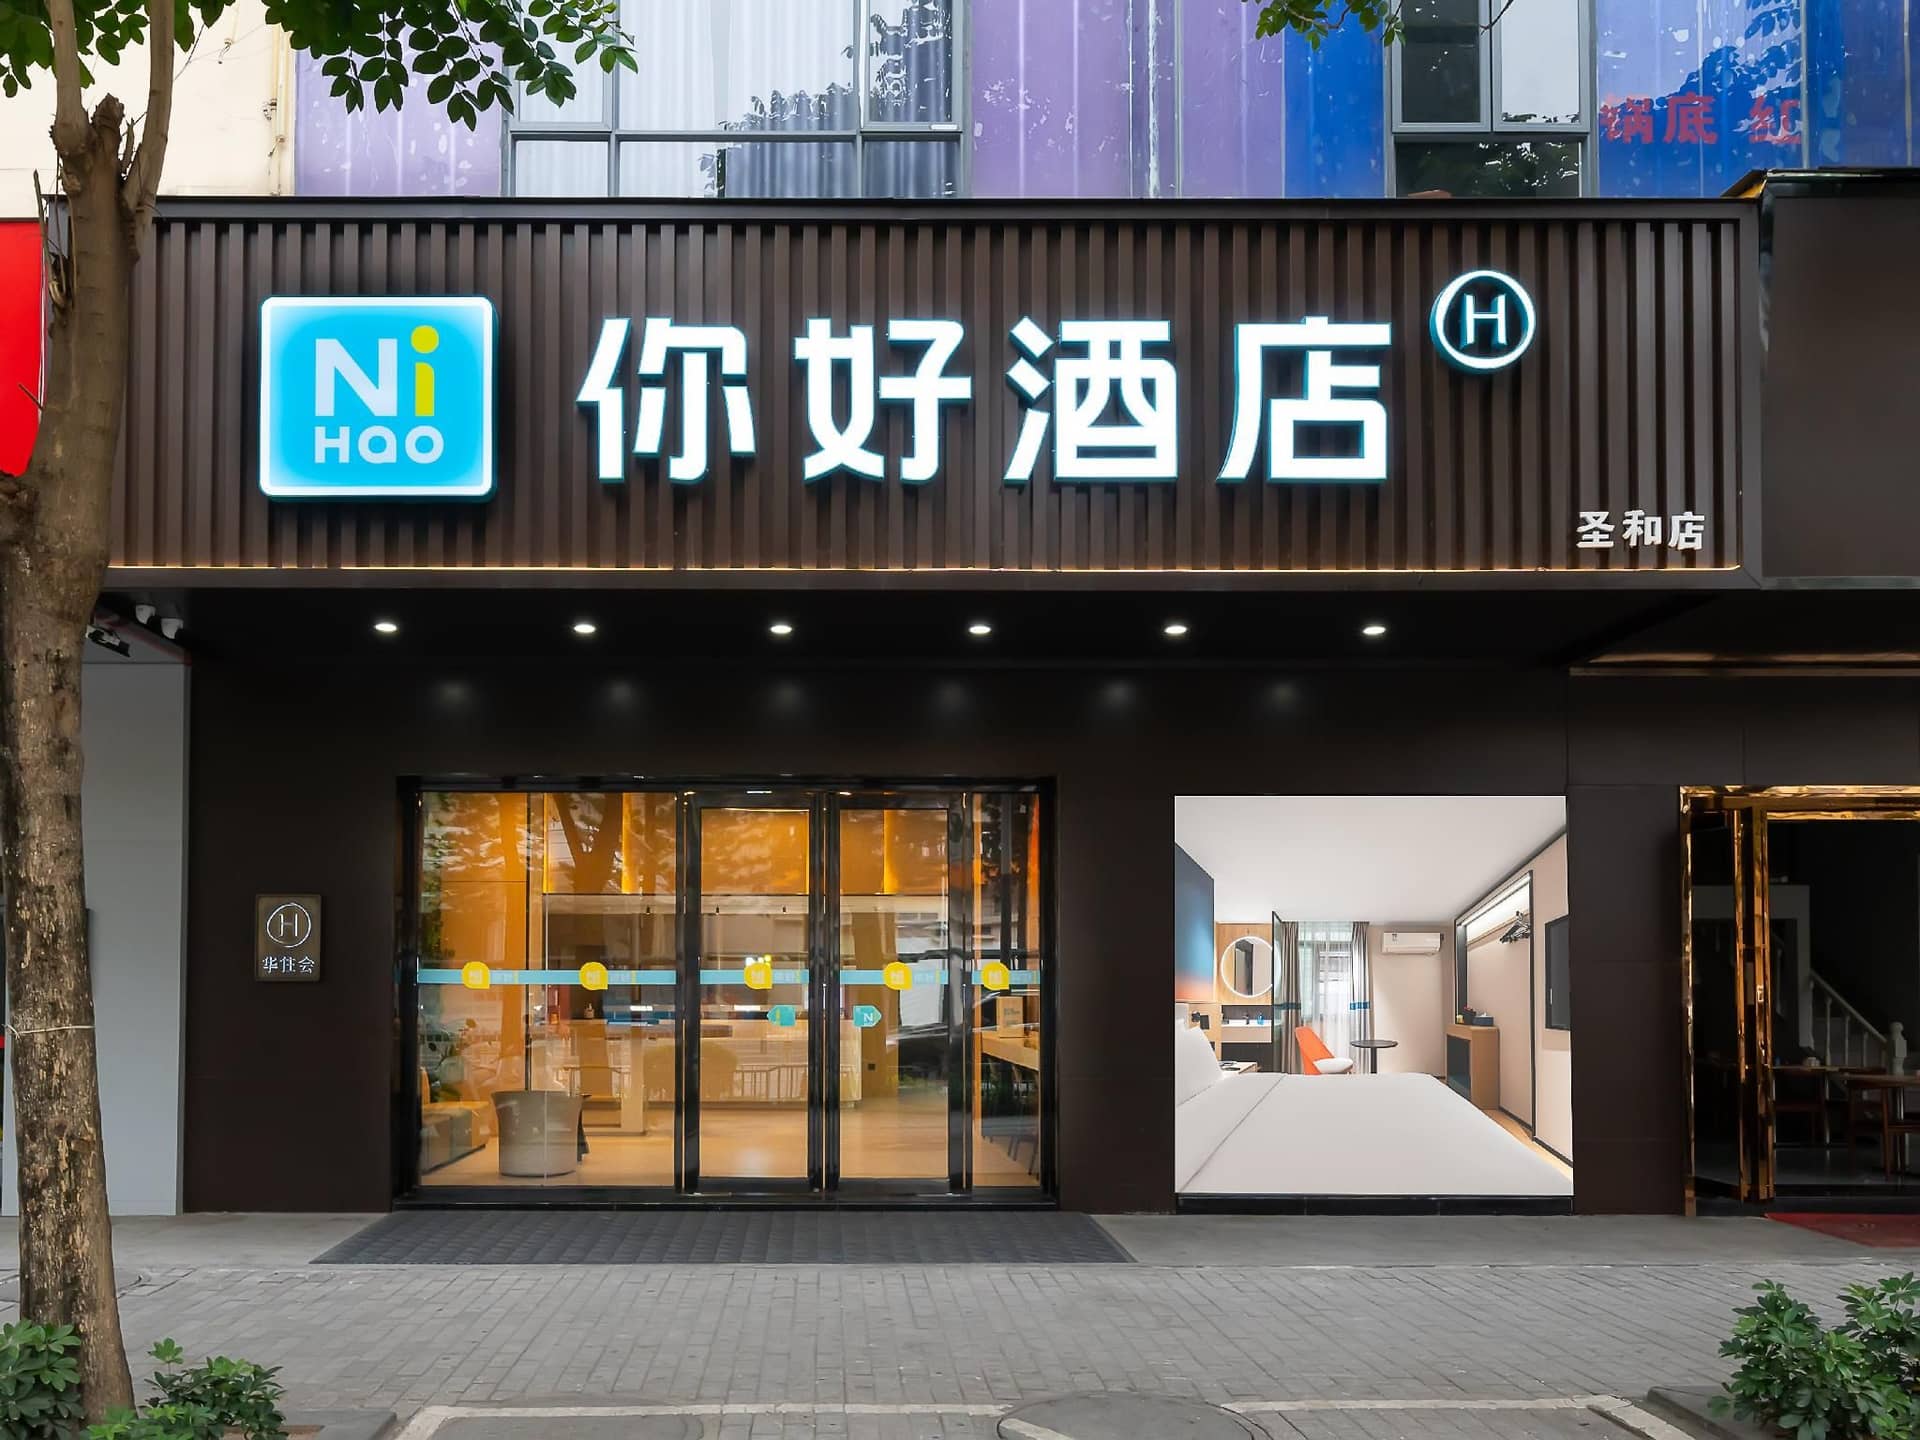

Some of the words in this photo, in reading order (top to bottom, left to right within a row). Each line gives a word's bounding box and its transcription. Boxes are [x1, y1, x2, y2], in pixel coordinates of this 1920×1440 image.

[1600, 92, 1718, 144] 锅底
[315, 325, 440, 417] Ni
[576, 315, 1393, 486] 你好酒店
[1576, 509, 1705, 551] 圣和店
[262, 955, 315, 975] 华住会
